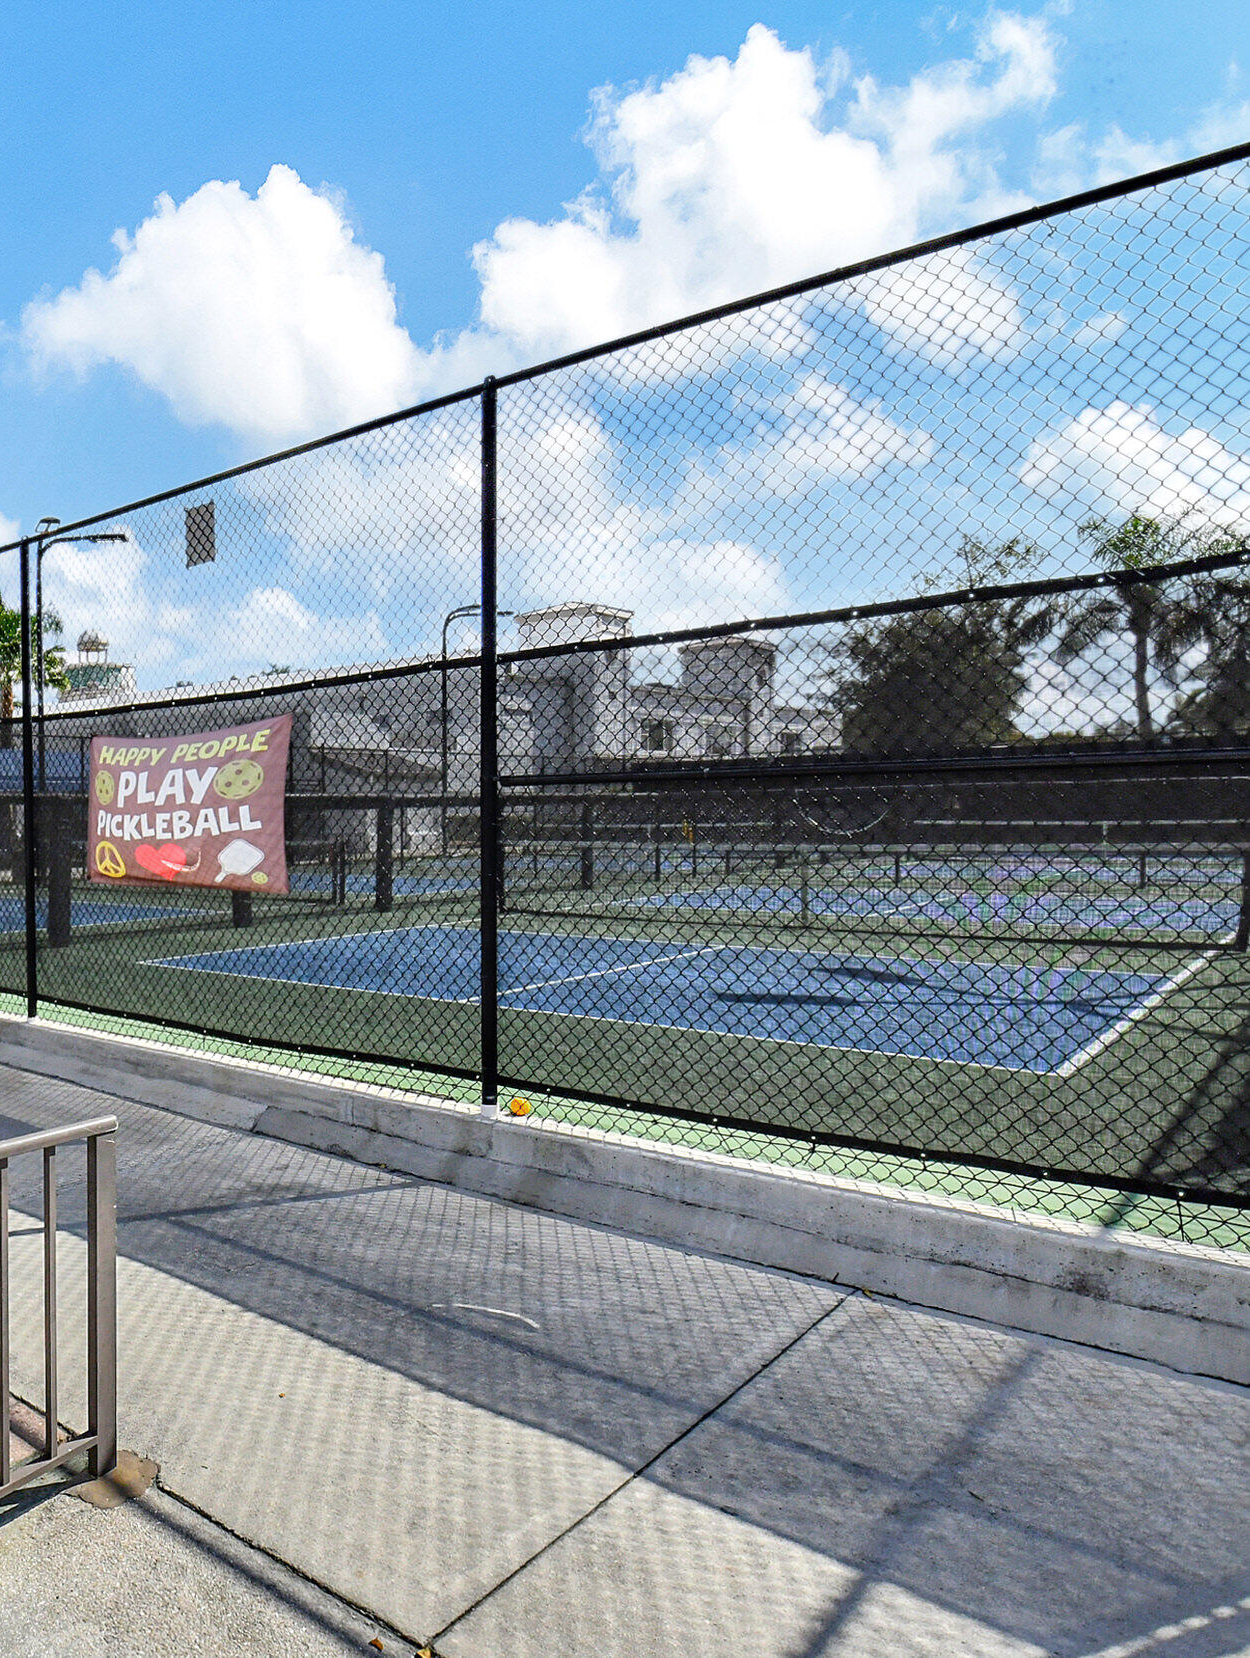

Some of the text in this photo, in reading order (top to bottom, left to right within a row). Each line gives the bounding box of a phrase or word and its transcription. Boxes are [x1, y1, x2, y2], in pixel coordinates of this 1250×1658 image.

[99, 729, 270, 767] HAPPY PEOPLE
[117, 766, 218, 808] PLAY
[97, 804, 262, 841] PICKLEBALL
